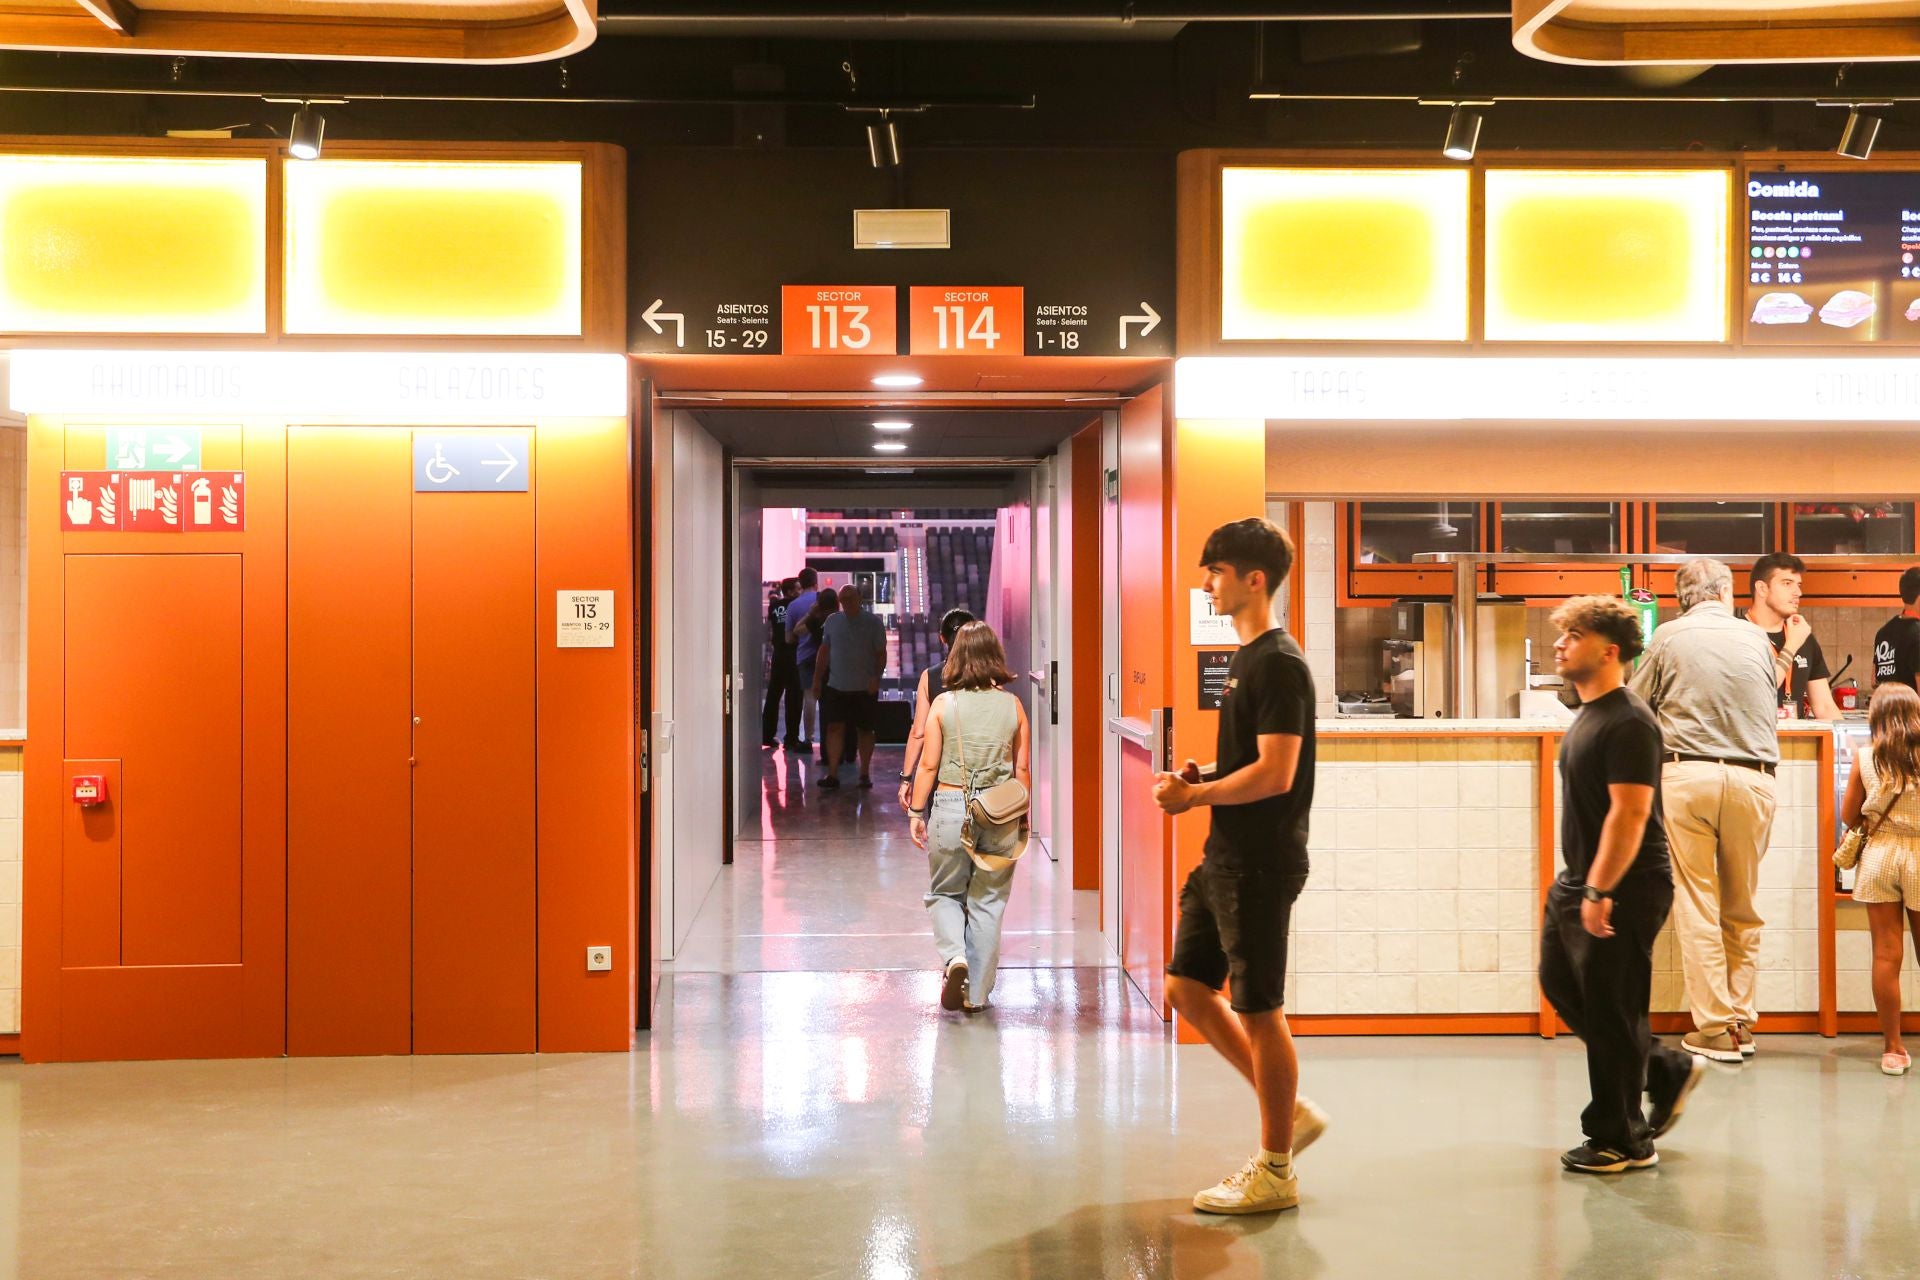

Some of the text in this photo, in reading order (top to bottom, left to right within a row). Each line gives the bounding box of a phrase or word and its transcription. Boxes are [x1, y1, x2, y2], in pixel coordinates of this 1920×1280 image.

[1748, 180, 1820, 198] Comida
[1761, 272, 1770, 283] €
[1792, 272, 1802, 283] €
[816, 291, 861, 302] SECTOR
[944, 292, 989, 302] SECTOR
[717, 304, 769, 314] ASIENTOS
[1036, 305, 1088, 316] ASIENTOS
[717, 316, 737, 324] Seats
[741, 316, 769, 324] Seients
[806, 305, 871, 349] 113
[1036, 318, 1056, 326] Seats
[1061, 318, 1088, 326] Seients
[933, 306, 1001, 350] 114
[705, 330, 726, 348] 15
[742, 330, 768, 348] 29
[1036, 331, 1043, 349] 1
[1059, 331, 1079, 350] 18
[92, 364, 241, 399] AHUMADOS
[399, 366, 545, 400] SALAZONES
[1291, 370, 1367, 405] TAPAS
[575, 604, 596, 618] 113
[584, 622, 592, 630] 15
[599, 622, 610, 630] 29
